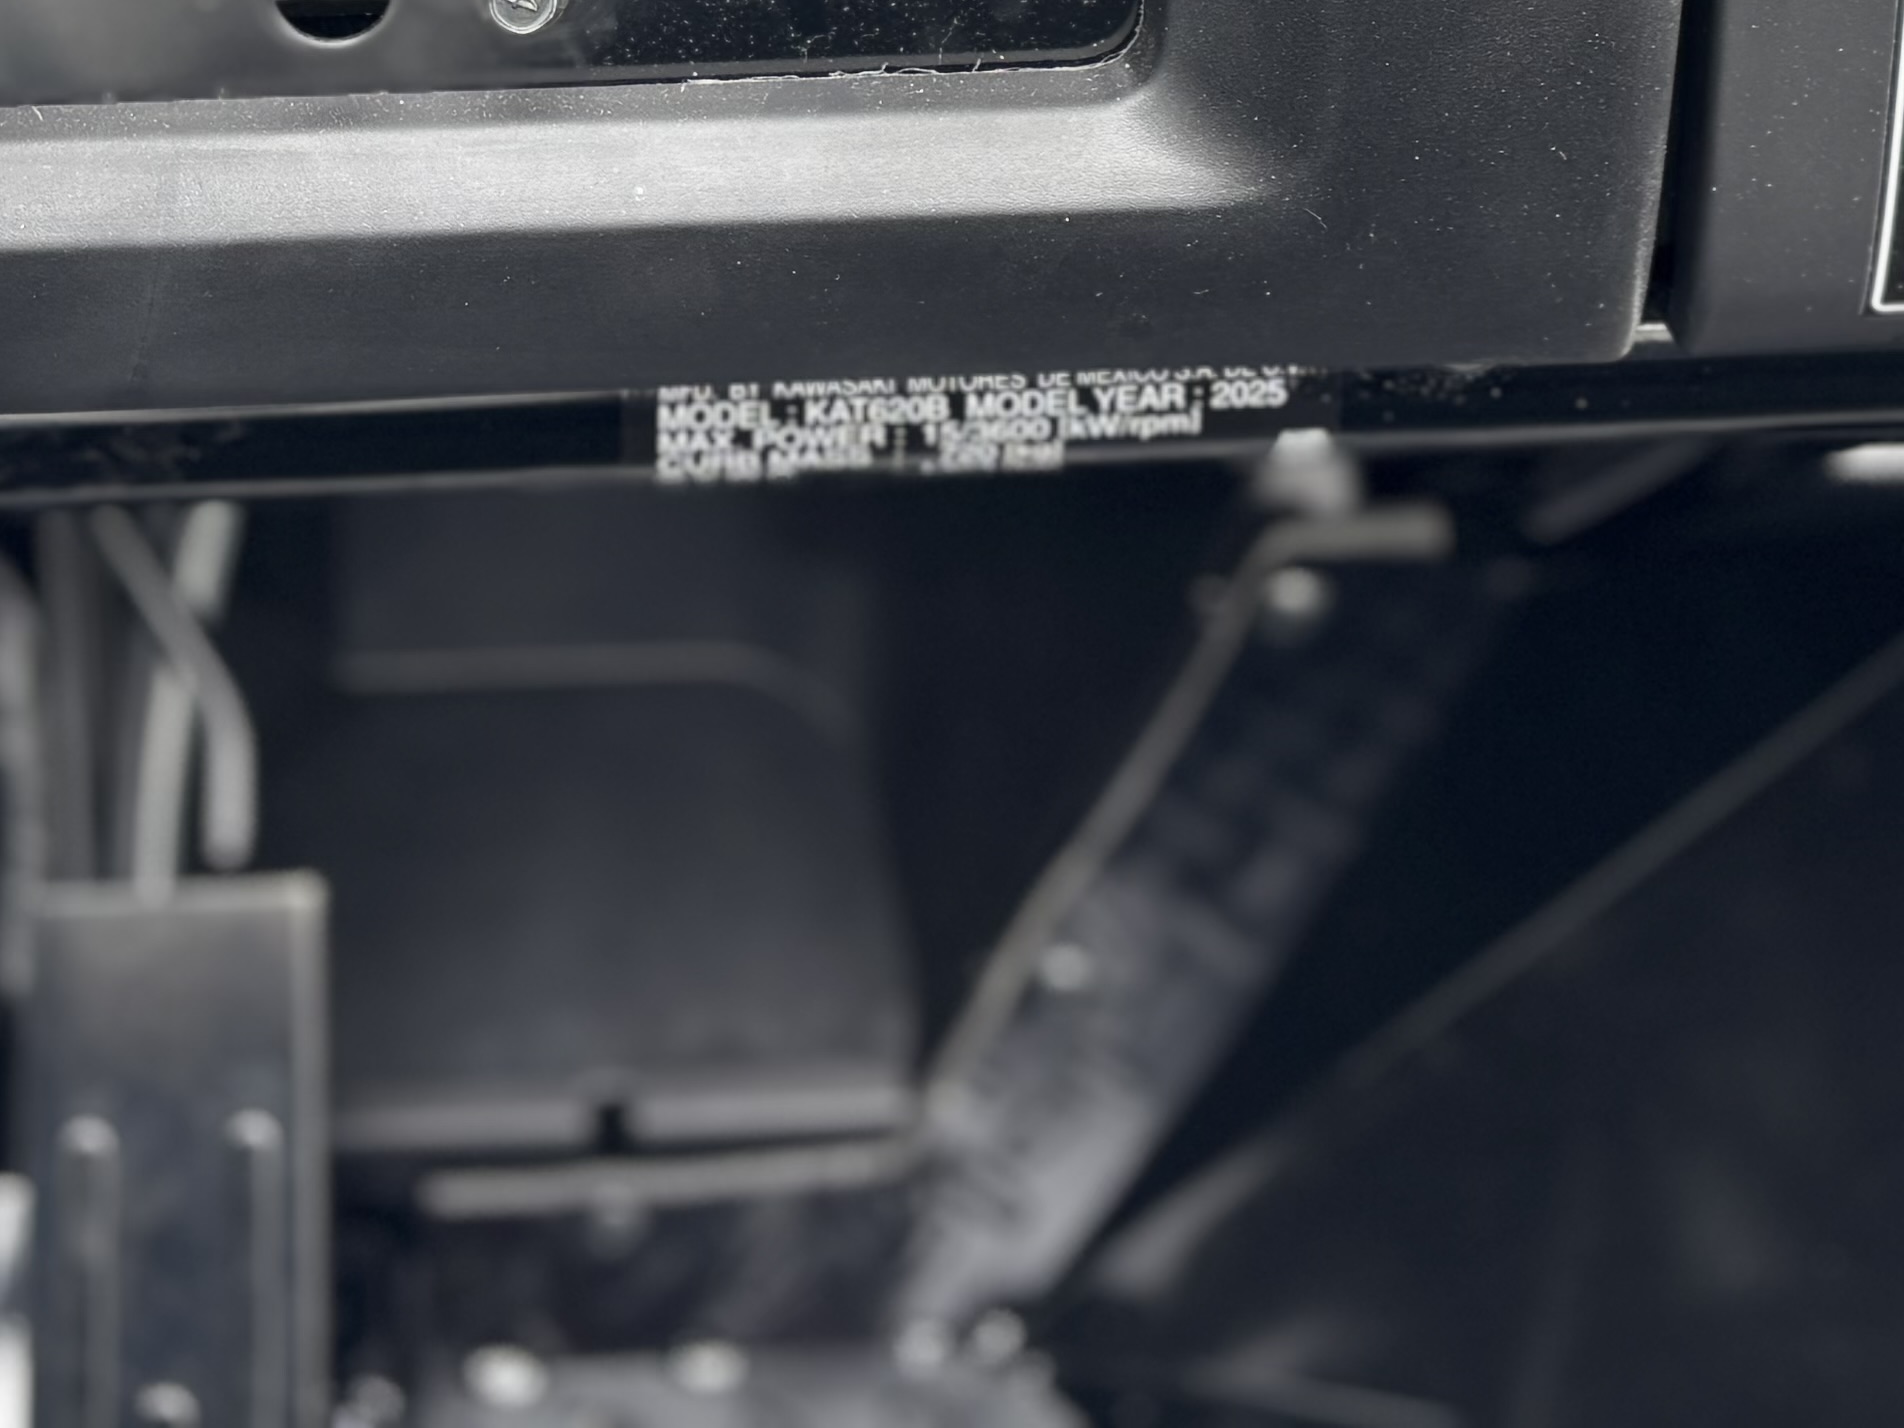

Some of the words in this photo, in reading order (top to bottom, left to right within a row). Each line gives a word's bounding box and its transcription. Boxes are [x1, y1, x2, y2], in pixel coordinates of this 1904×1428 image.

[657, 402, 778, 431] MODEL
[804, 395, 949, 425] KAT620B
[965, 388, 1087, 418] MODEL
[1094, 383, 1186, 413] YEAR
[1210, 379, 1286, 408] 2025
[752, 423, 886, 451] POWER
